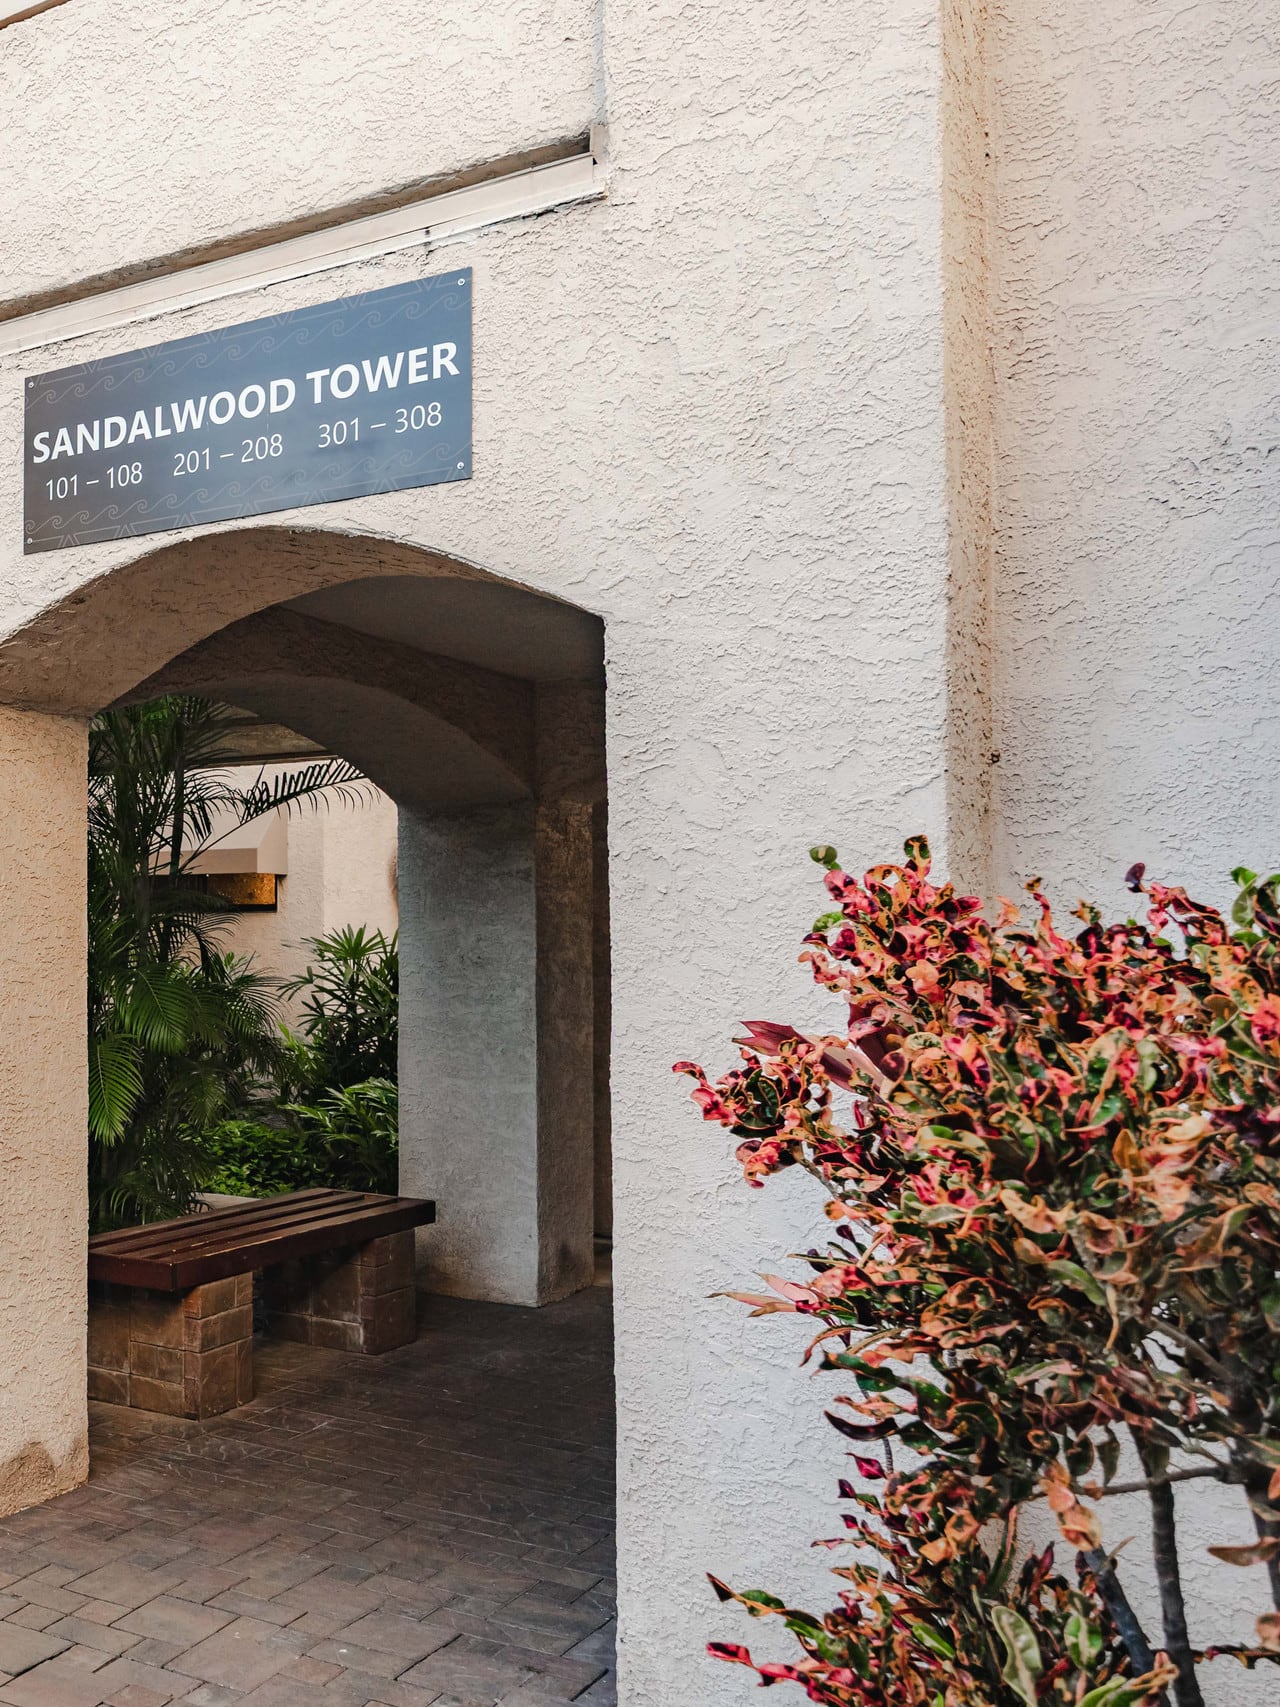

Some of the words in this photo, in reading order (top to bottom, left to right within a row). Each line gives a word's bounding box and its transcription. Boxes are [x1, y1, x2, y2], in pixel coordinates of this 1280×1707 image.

[32, 378, 297, 464] SANDALWOOD
[305, 341, 461, 405] TOWER
[45, 474, 79, 501] 101
[105, 461, 144, 490] 108
[173, 447, 210, 477] 201
[240, 433, 284, 463] 208
[317, 416, 359, 448] 301
[394, 401, 442, 434] 308
